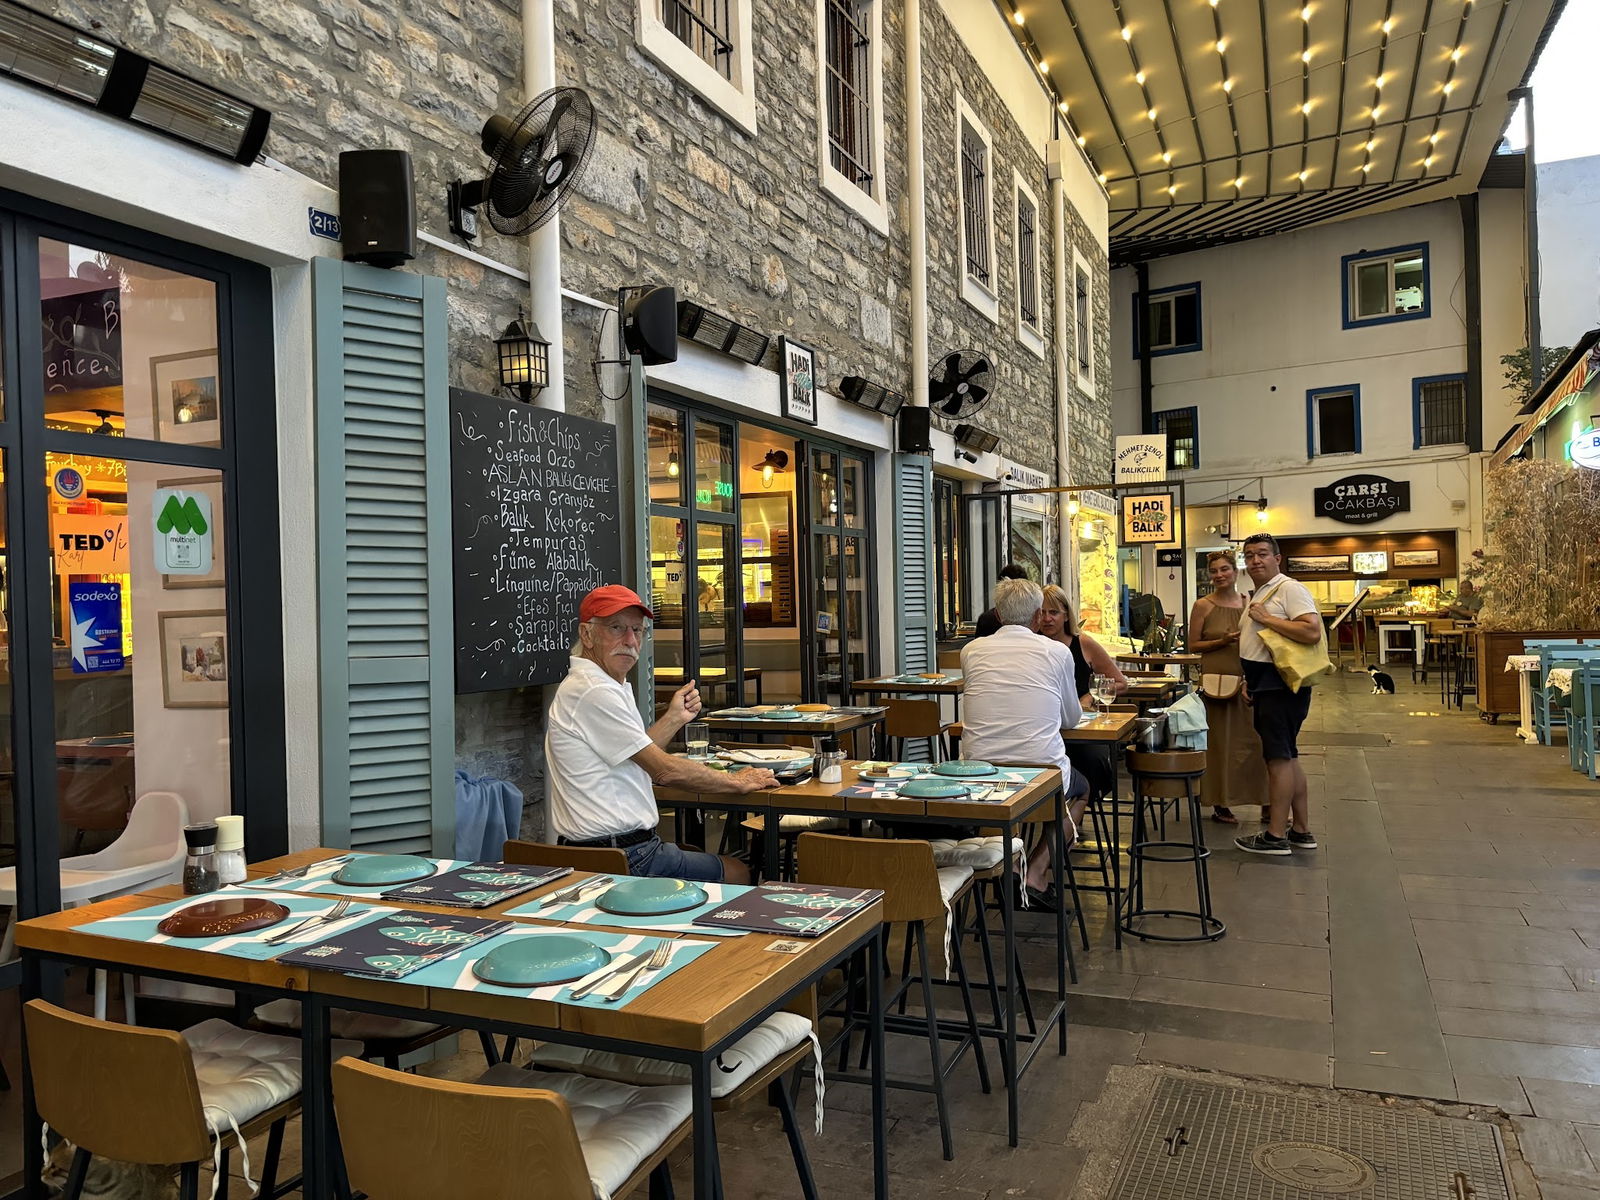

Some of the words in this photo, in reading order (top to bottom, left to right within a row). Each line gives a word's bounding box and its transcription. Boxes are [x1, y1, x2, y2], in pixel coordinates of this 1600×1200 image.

[495, 440, 541, 466] Seafood
[547, 449, 576, 469] Orzo
[1118, 444, 1144, 461] MEHMET
[488, 463, 543, 488] ASLAN
[497, 485, 542, 504] Izgara
[549, 490, 595, 514] Granyöz
[1334, 482, 1388, 501] ÇARŞI
[1324, 496, 1400, 511] OCAKBAŞI
[545, 507, 595, 535] Kokoreç
[59, 534, 104, 550] TED
[74, 591, 118, 602] sodexo
[515, 616, 578, 638] Şaraplar
[517, 632, 571, 654] Cocktails
